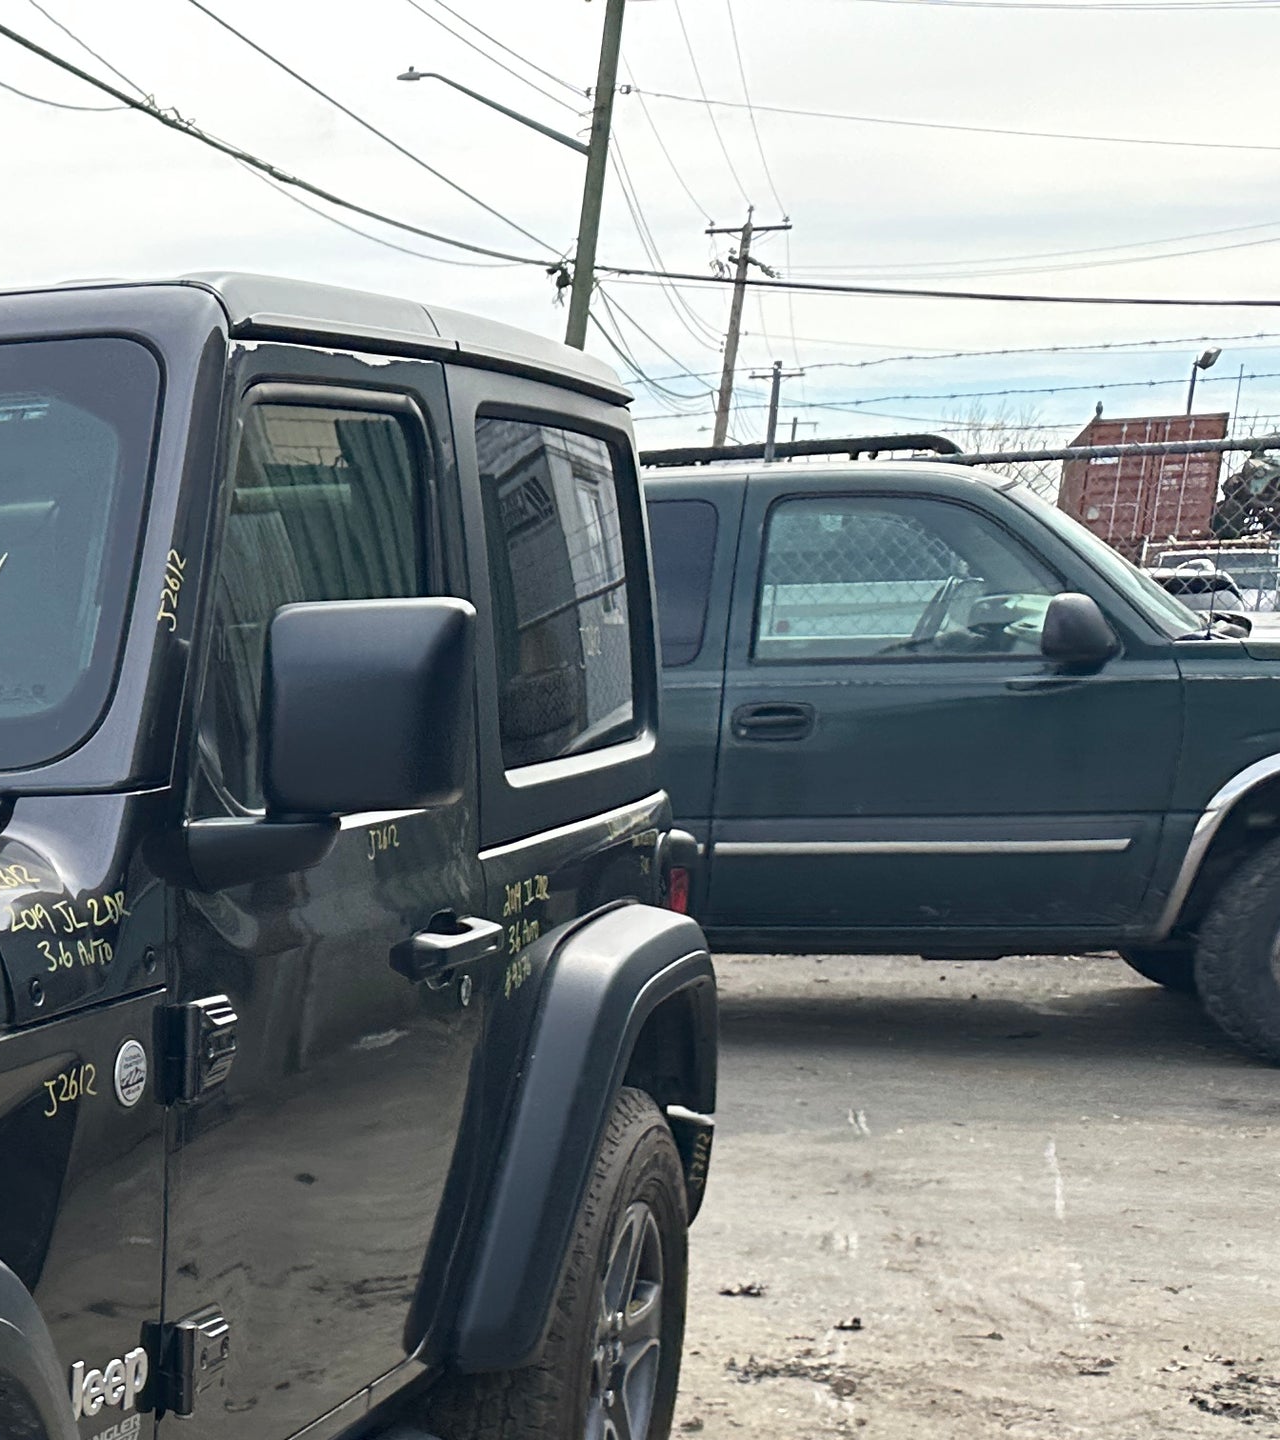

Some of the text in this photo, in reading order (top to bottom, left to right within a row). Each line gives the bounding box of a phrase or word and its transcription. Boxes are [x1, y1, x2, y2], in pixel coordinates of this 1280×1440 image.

[157, 549, 187, 632] J2612
[4, 903, 57, 934] 2019
[52, 900, 89, 933] JL
[37, 940, 73, 972] 3.6
[44, 1063, 97, 1117] J2612
